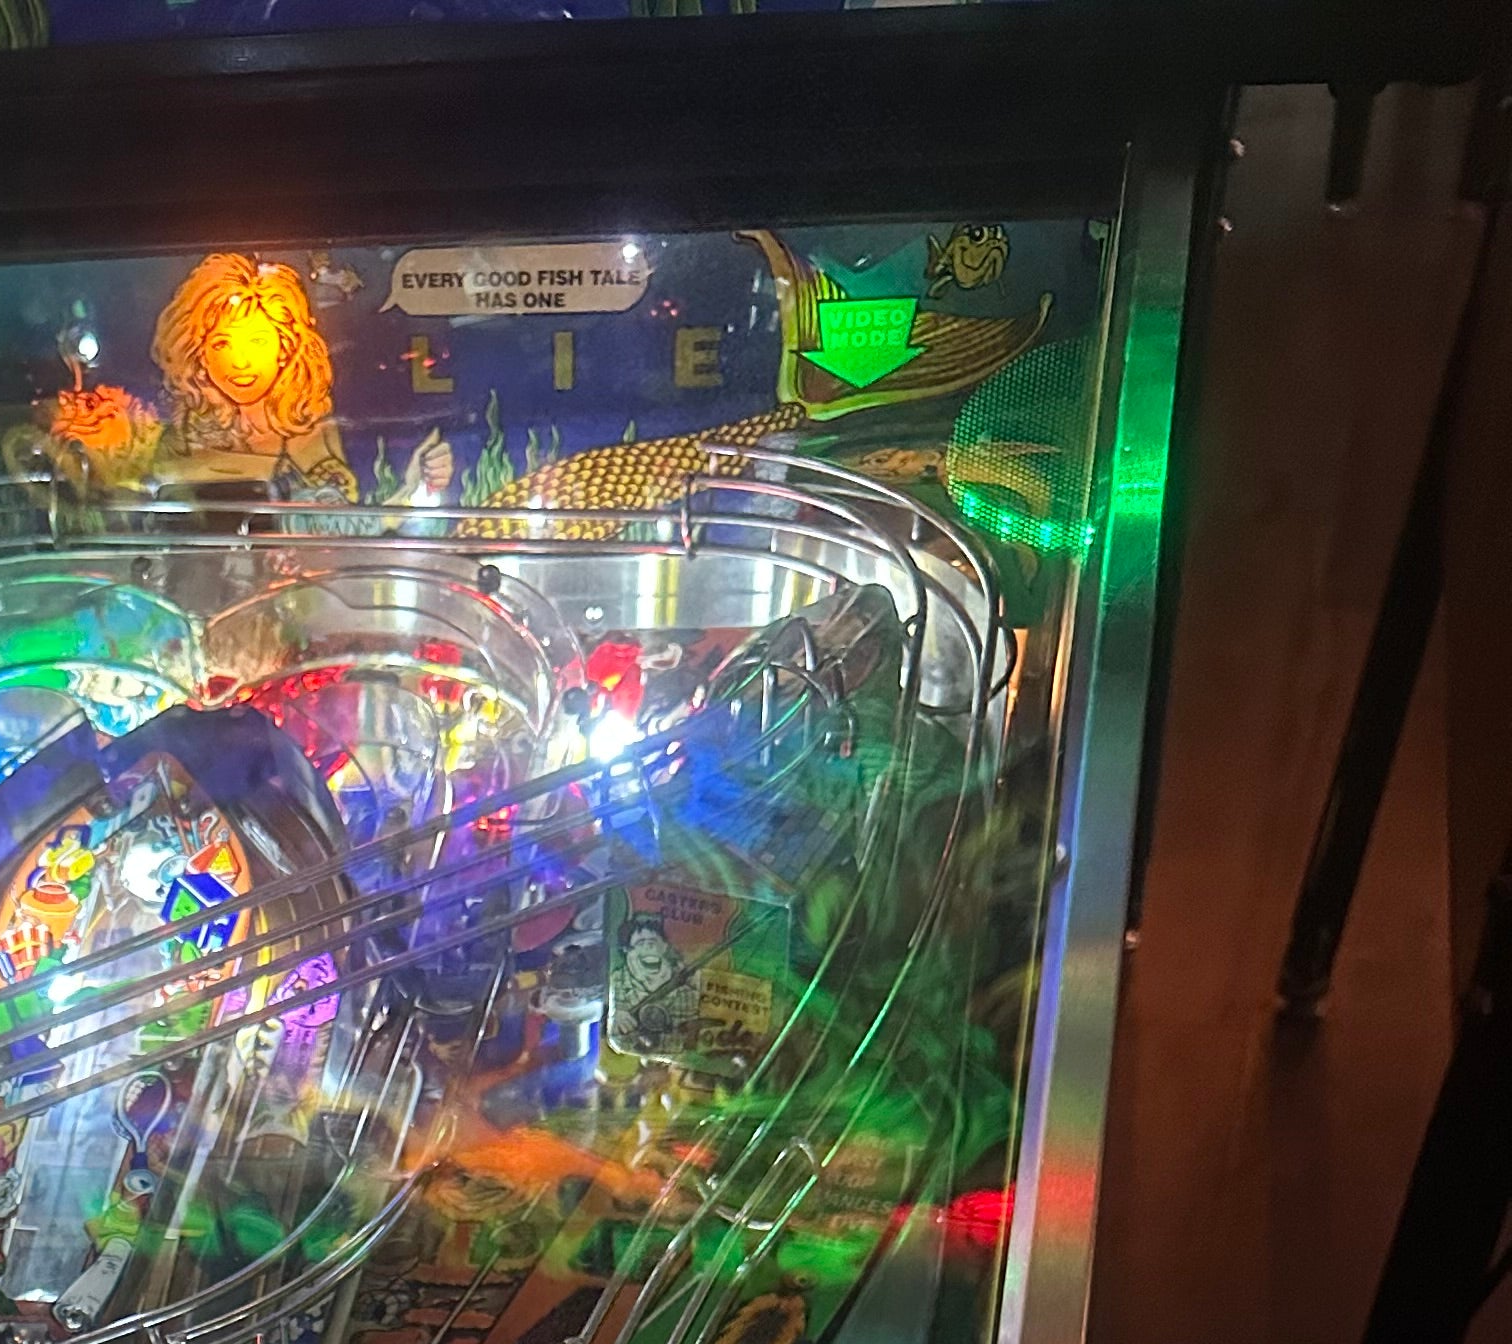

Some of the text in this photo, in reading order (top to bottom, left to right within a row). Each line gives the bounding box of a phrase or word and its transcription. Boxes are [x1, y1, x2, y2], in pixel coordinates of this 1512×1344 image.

[402, 268, 642, 290] EVERY GOOD FISH TALE
[475, 291, 566, 309] HAS ONE
[828, 309, 907, 329] VIDEO
[830, 329, 903, 350] MODE
[675, 327, 724, 388] E
